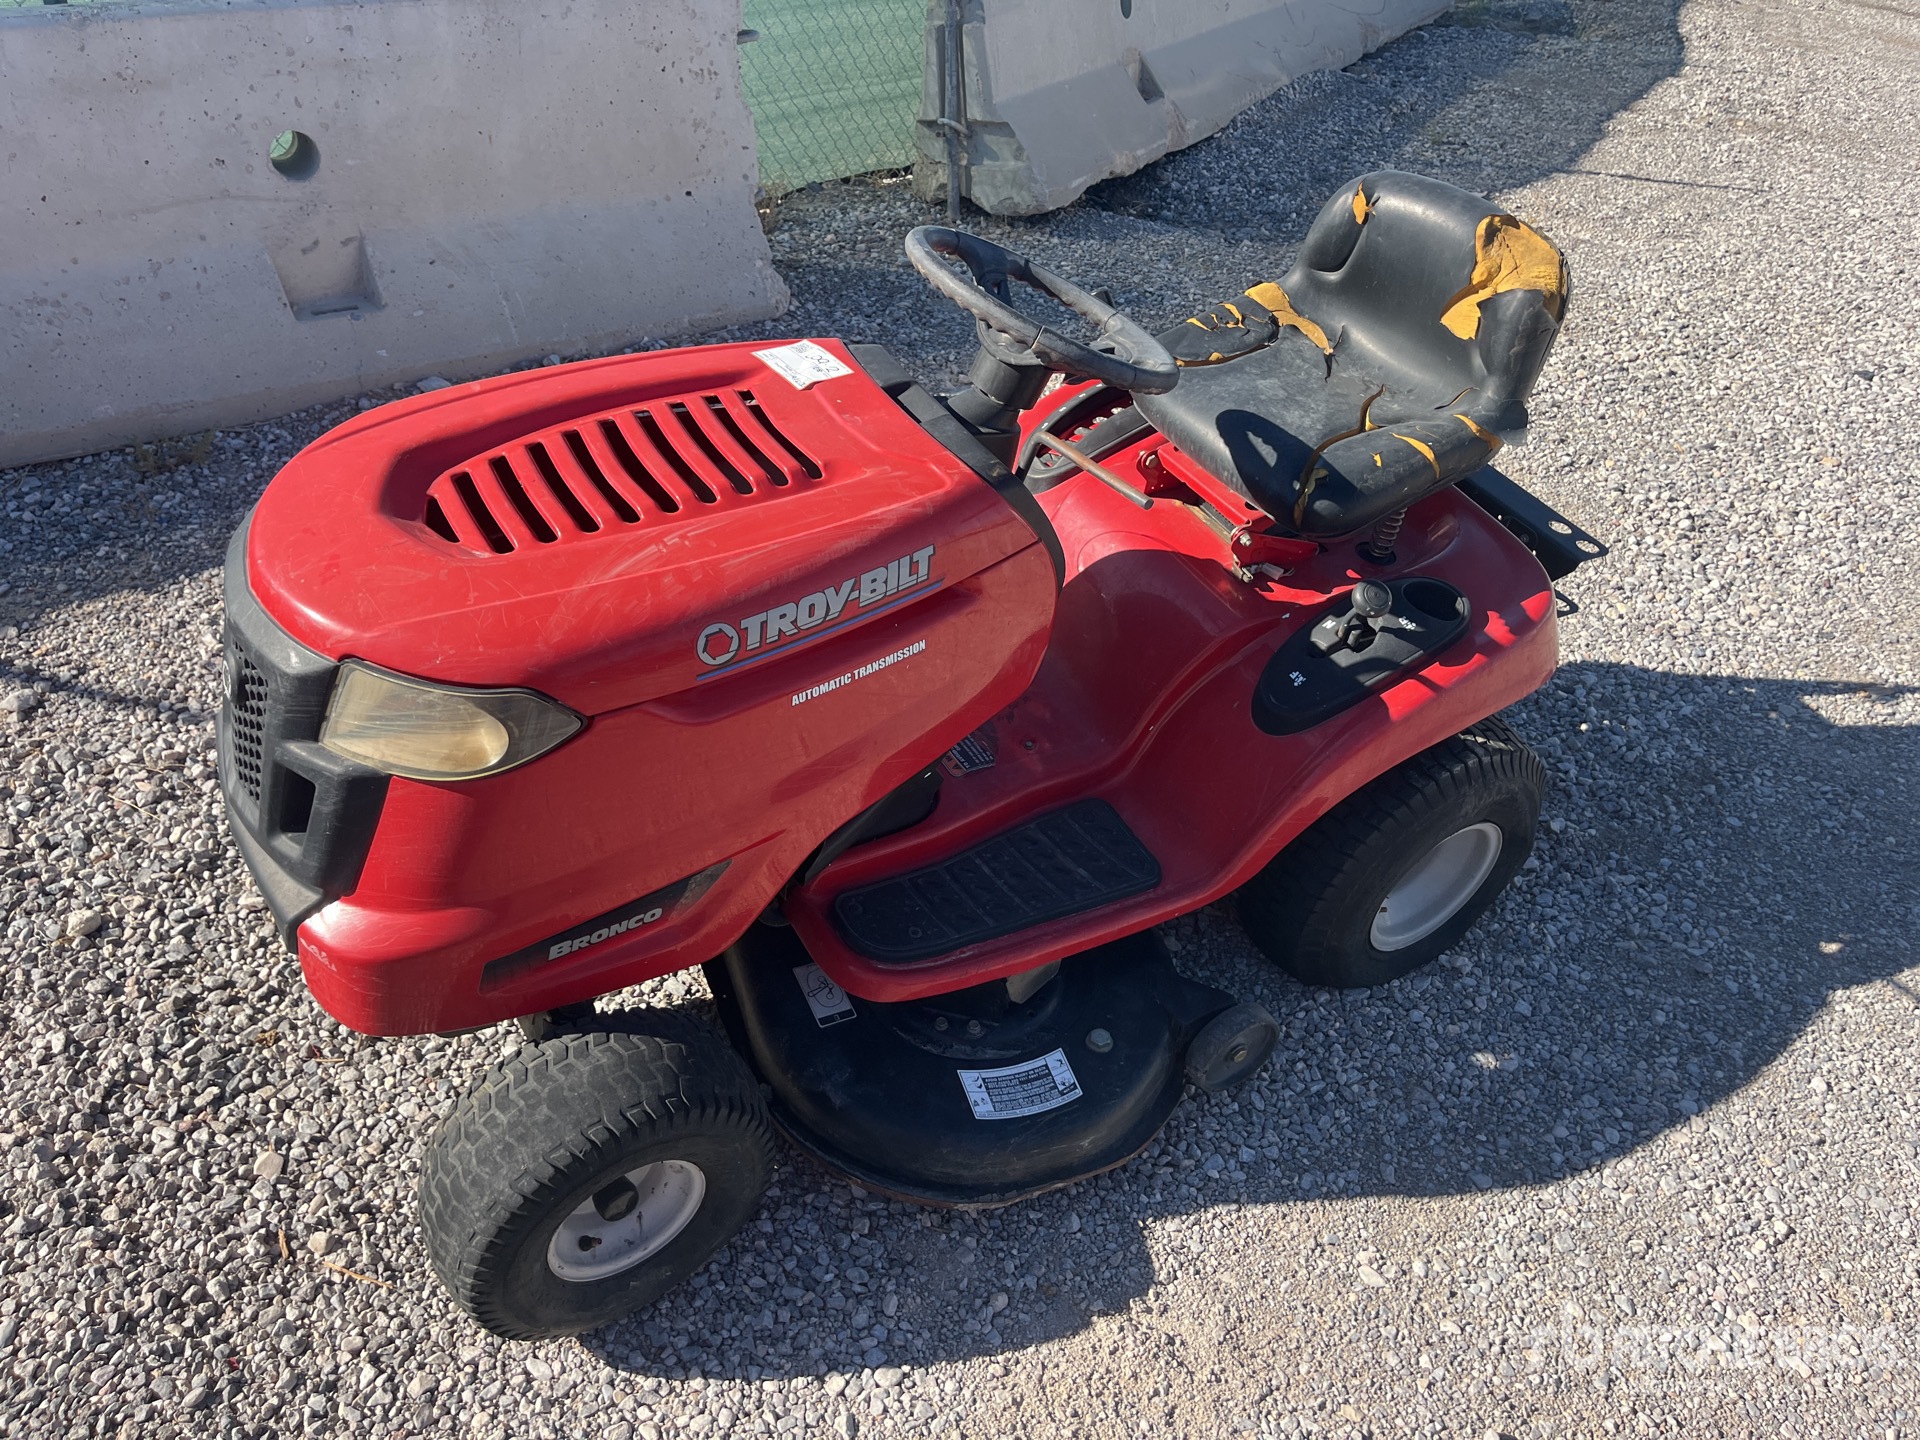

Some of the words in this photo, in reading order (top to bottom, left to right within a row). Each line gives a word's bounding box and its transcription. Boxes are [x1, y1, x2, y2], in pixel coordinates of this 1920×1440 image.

[740, 544, 936, 651] TROY-BILT
[1322, 620, 1336, 629] N
[791, 673, 852, 707] AUTOMATIC
[853, 639, 926, 681] TRANSMISSION
[547, 907, 663, 961] BRONCO
